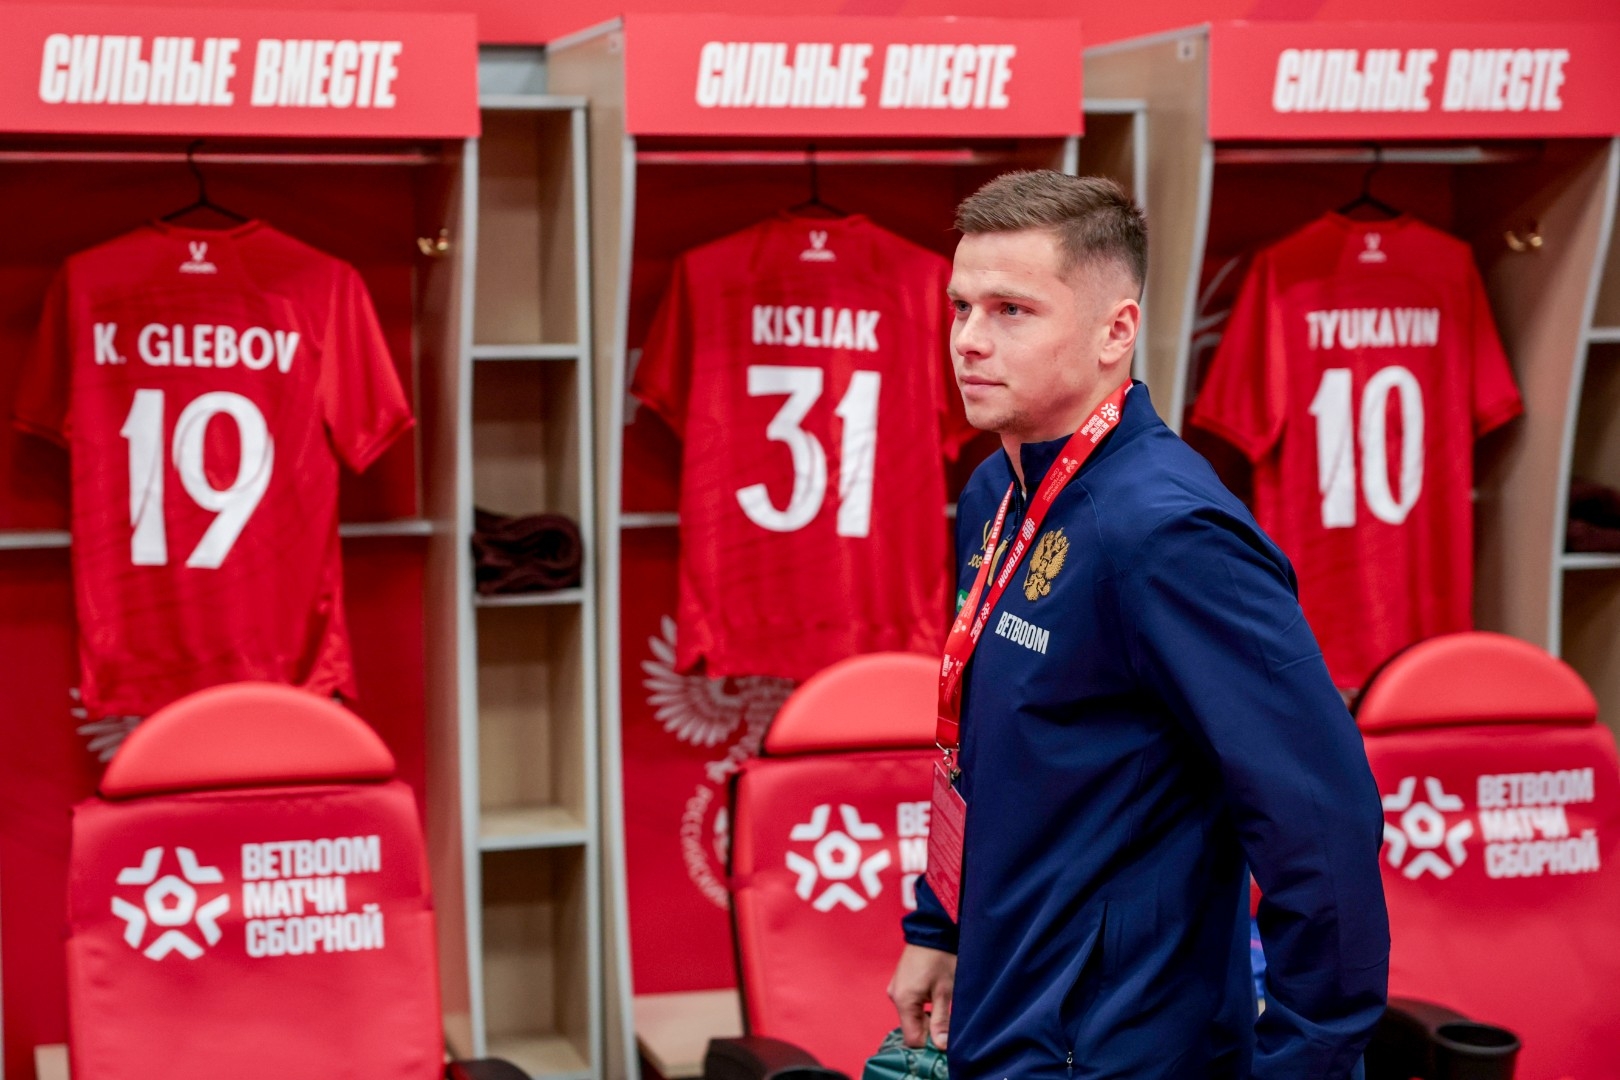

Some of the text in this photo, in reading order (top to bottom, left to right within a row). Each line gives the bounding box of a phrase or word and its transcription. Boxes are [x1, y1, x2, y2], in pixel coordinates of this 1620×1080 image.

[39, 33, 402, 109] СИЛЬНЫЕ ВМЕСТЕ
[695, 41, 1016, 109] СИЛЬНЫЕ ВМЕСТЕ
[1272, 48, 1570, 113] СИЛЬНЫЕ ВМЕСТЕ
[93, 321, 300, 374] K. GLEBOV
[752, 304, 881, 352] KISLIAK
[1305, 307, 1441, 351] TYUKAVIN
[735, 364, 882, 539] 31
[1307, 364, 1426, 530] 10
[119, 388, 275, 570] 19
[968, 554, 982, 569] JOG
[998, 540, 1025, 589] BETBOOM
[994, 610, 1051, 655] BETBOOM
[1477, 767, 1595, 808] BETBOOM
[679, 783, 730, 910] РОССИЙСКИ
[1478, 804, 1570, 842] МАТЧИ
[241, 834, 381, 881] BETBOOM
[1484, 828, 1601, 879] СБОРНОЙ
[242, 875, 347, 919] МАТЧИ
[245, 903, 385, 958] СБОРНОЙ
